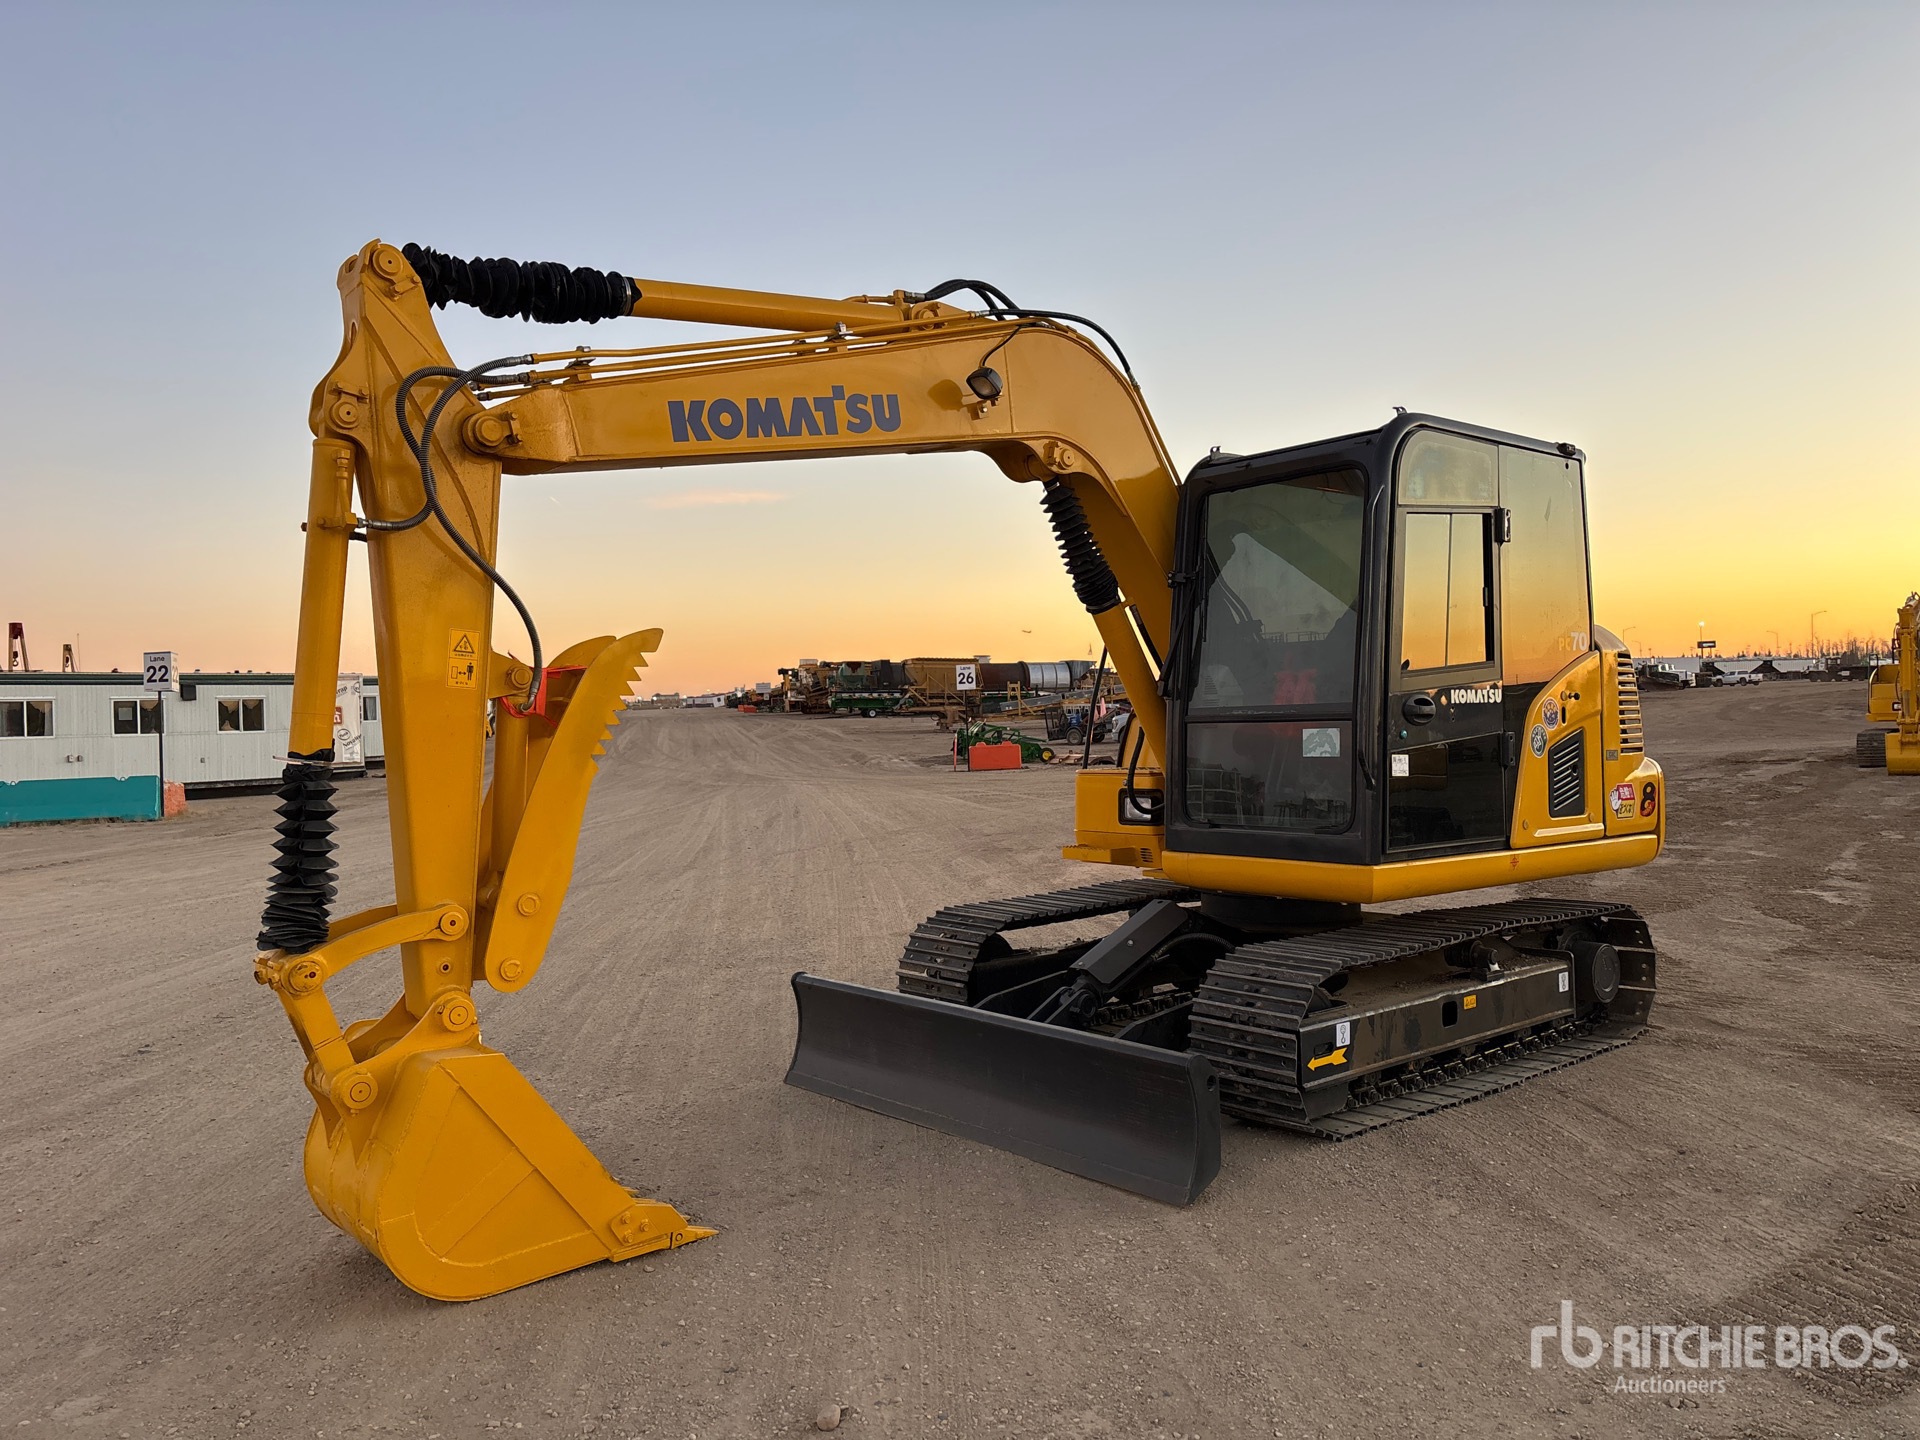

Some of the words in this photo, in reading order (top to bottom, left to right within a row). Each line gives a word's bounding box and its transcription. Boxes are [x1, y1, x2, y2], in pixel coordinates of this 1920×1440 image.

[667, 385, 901, 442] KOMATSU
[1558, 631, 1588, 651] PC70
[146, 665, 169, 683] 22
[958, 672, 974, 685] 26
[1450, 685, 1503, 704] KOMATSU
